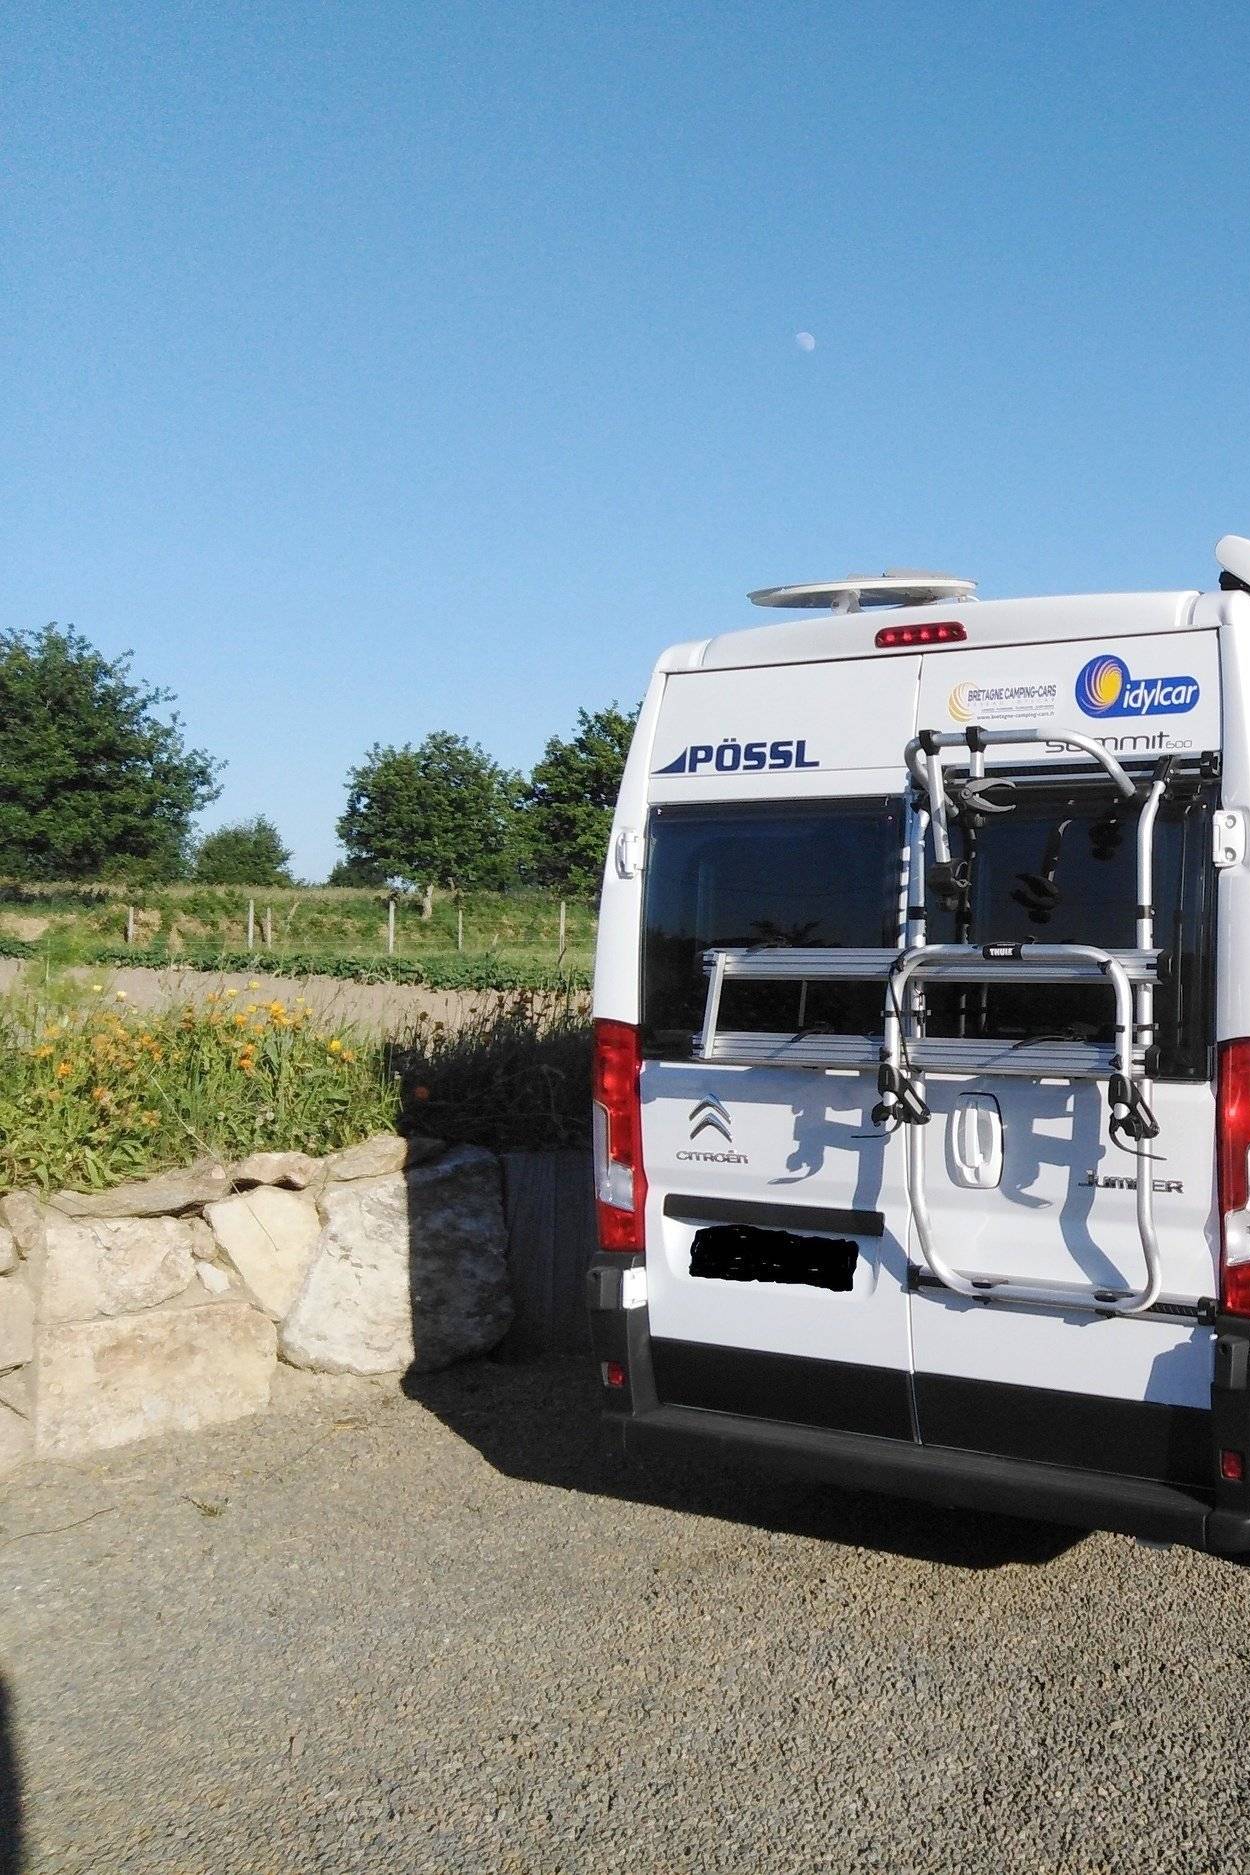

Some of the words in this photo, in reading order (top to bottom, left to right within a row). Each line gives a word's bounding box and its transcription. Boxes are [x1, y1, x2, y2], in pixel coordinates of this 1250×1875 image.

[967, 688, 1004, 702] BRETAGNE
[1005, 684, 1057, 700] CAMPING-CARS
[1123, 680, 1198, 715] idylcar
[1166, 740, 1193, 749] 600
[688, 738, 820, 773] PÖSSL
[990, 947, 1013, 956] THULE
[676, 1150, 749, 1164] CITROËN
[1078, 1169, 1184, 1193] JUMER
